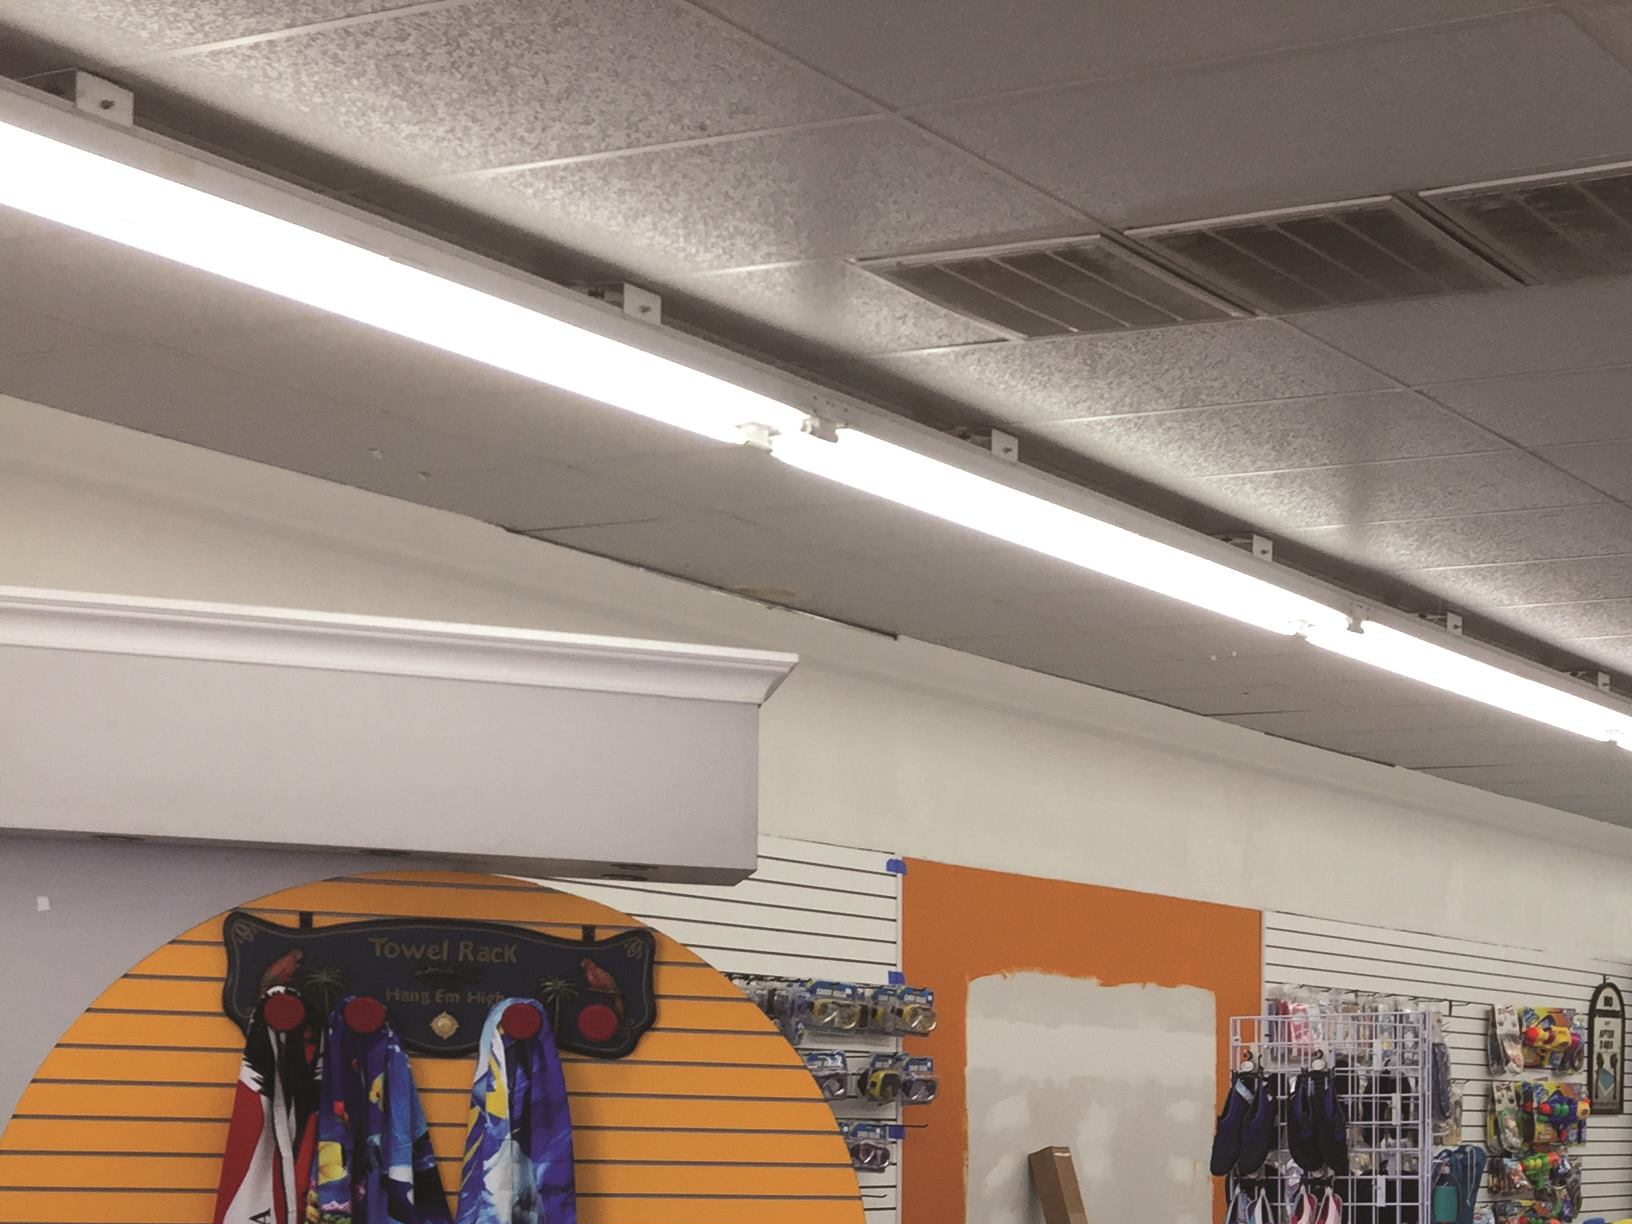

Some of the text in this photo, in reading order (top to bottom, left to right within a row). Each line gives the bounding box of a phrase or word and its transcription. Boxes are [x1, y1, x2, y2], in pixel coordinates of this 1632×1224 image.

[367, 936, 518, 964] Towel Rack
[385, 986, 431, 1006] Hang
